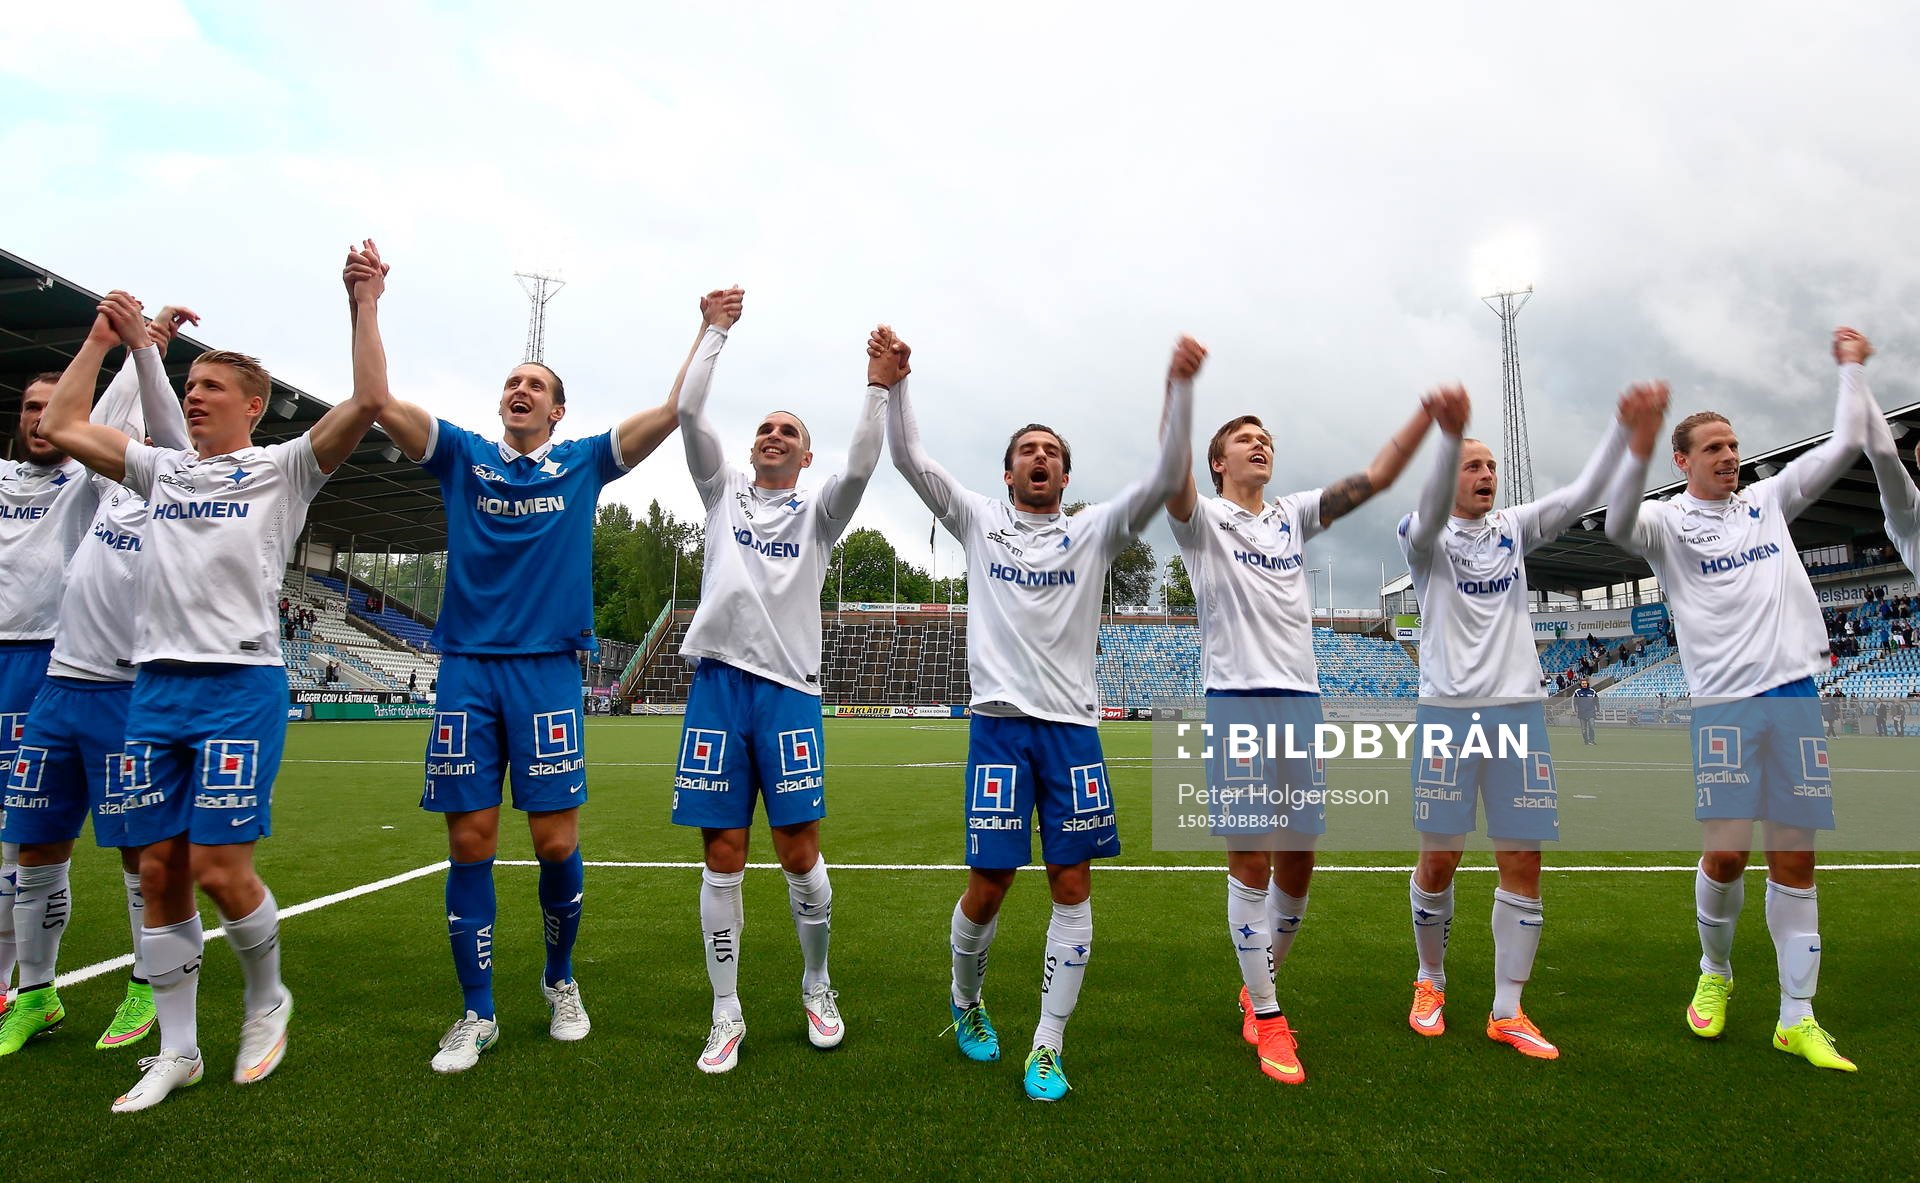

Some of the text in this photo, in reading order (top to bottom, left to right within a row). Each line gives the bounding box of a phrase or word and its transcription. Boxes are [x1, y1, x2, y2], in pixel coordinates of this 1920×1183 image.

[152, 501, 249, 520] HOLMEN
[477, 495, 564, 517] HOLMEN
[1701, 543, 1780, 575] HOLMEN
[989, 562, 1076, 586] HOLMEN
[1902, 581, 1916, 593] en
[297, 691, 321, 703] LÄGGER
[321, 693, 339, 703] GOLV
[344, 692, 363, 703] SÄTTER
[838, 706, 890, 714] BLÅKLÄDER
[894, 707, 918, 715] DALOC
[529, 757, 584, 776] stadium
[675, 774, 729, 793] stadium
[1697, 769, 1750, 785] stadium
[4, 794, 49, 809] adium
[672, 790, 679, 811] 8
[1415, 785, 1462, 802] stadium
[1697, 786, 1711, 808] 21
[969, 815, 1023, 830] stadium
[1062, 813, 1115, 832] stadium
[970, 833, 979, 855] 11
[42, 888, 68, 931] SITA
[476, 924, 492, 971] SITA
[713, 928, 734, 963] SITA
[1041, 951, 1058, 994] SITA
